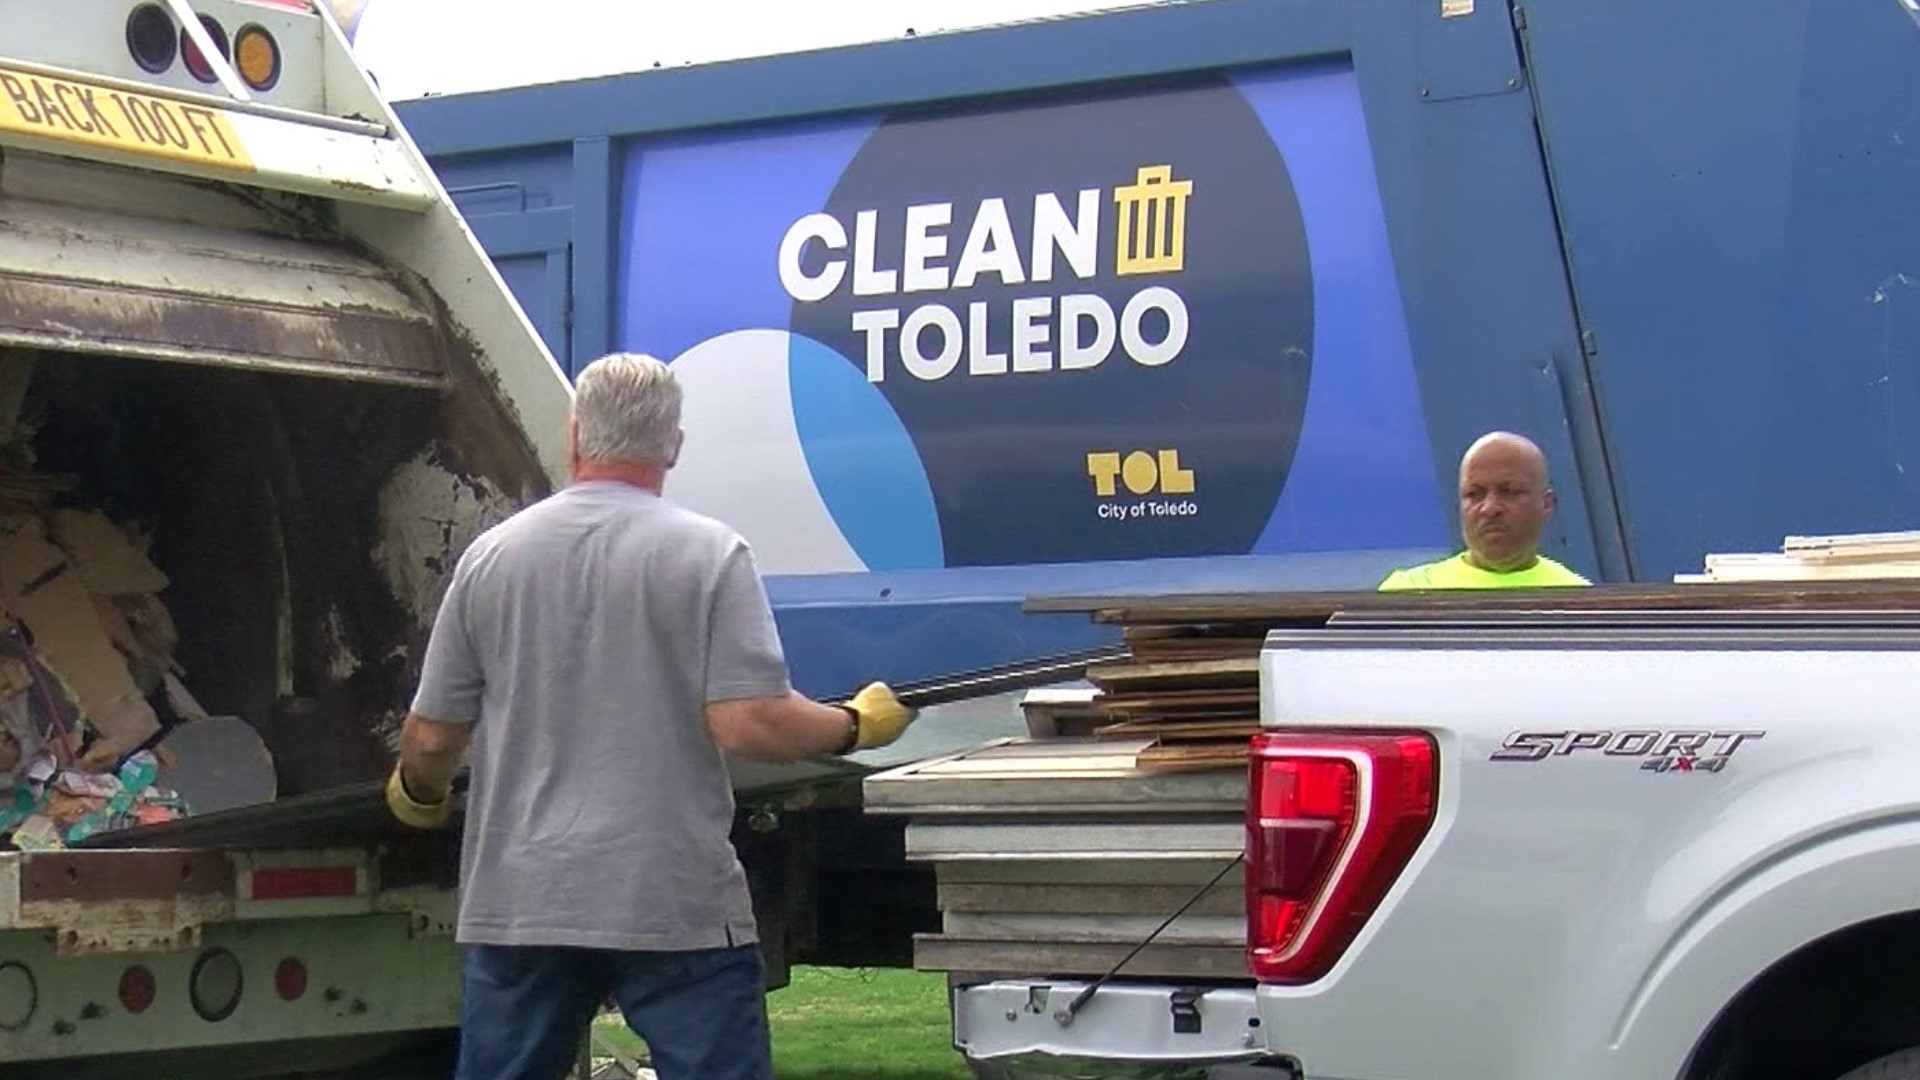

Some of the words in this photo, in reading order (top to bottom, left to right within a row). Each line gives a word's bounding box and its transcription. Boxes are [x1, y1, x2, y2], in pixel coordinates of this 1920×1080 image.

[1, 73, 120, 138] BACK
[110, 93, 189, 150] 100
[178, 105, 235, 159] FT
[778, 188, 1100, 301] CLEAN
[852, 286, 1189, 383] TOLEDO
[1087, 449, 1195, 496] TOL
[1097, 503, 1127, 520] City
[1130, 501, 1146, 517] of
[1148, 500, 1198, 516] Toledo
[1488, 729, 1766, 762] SPORT
